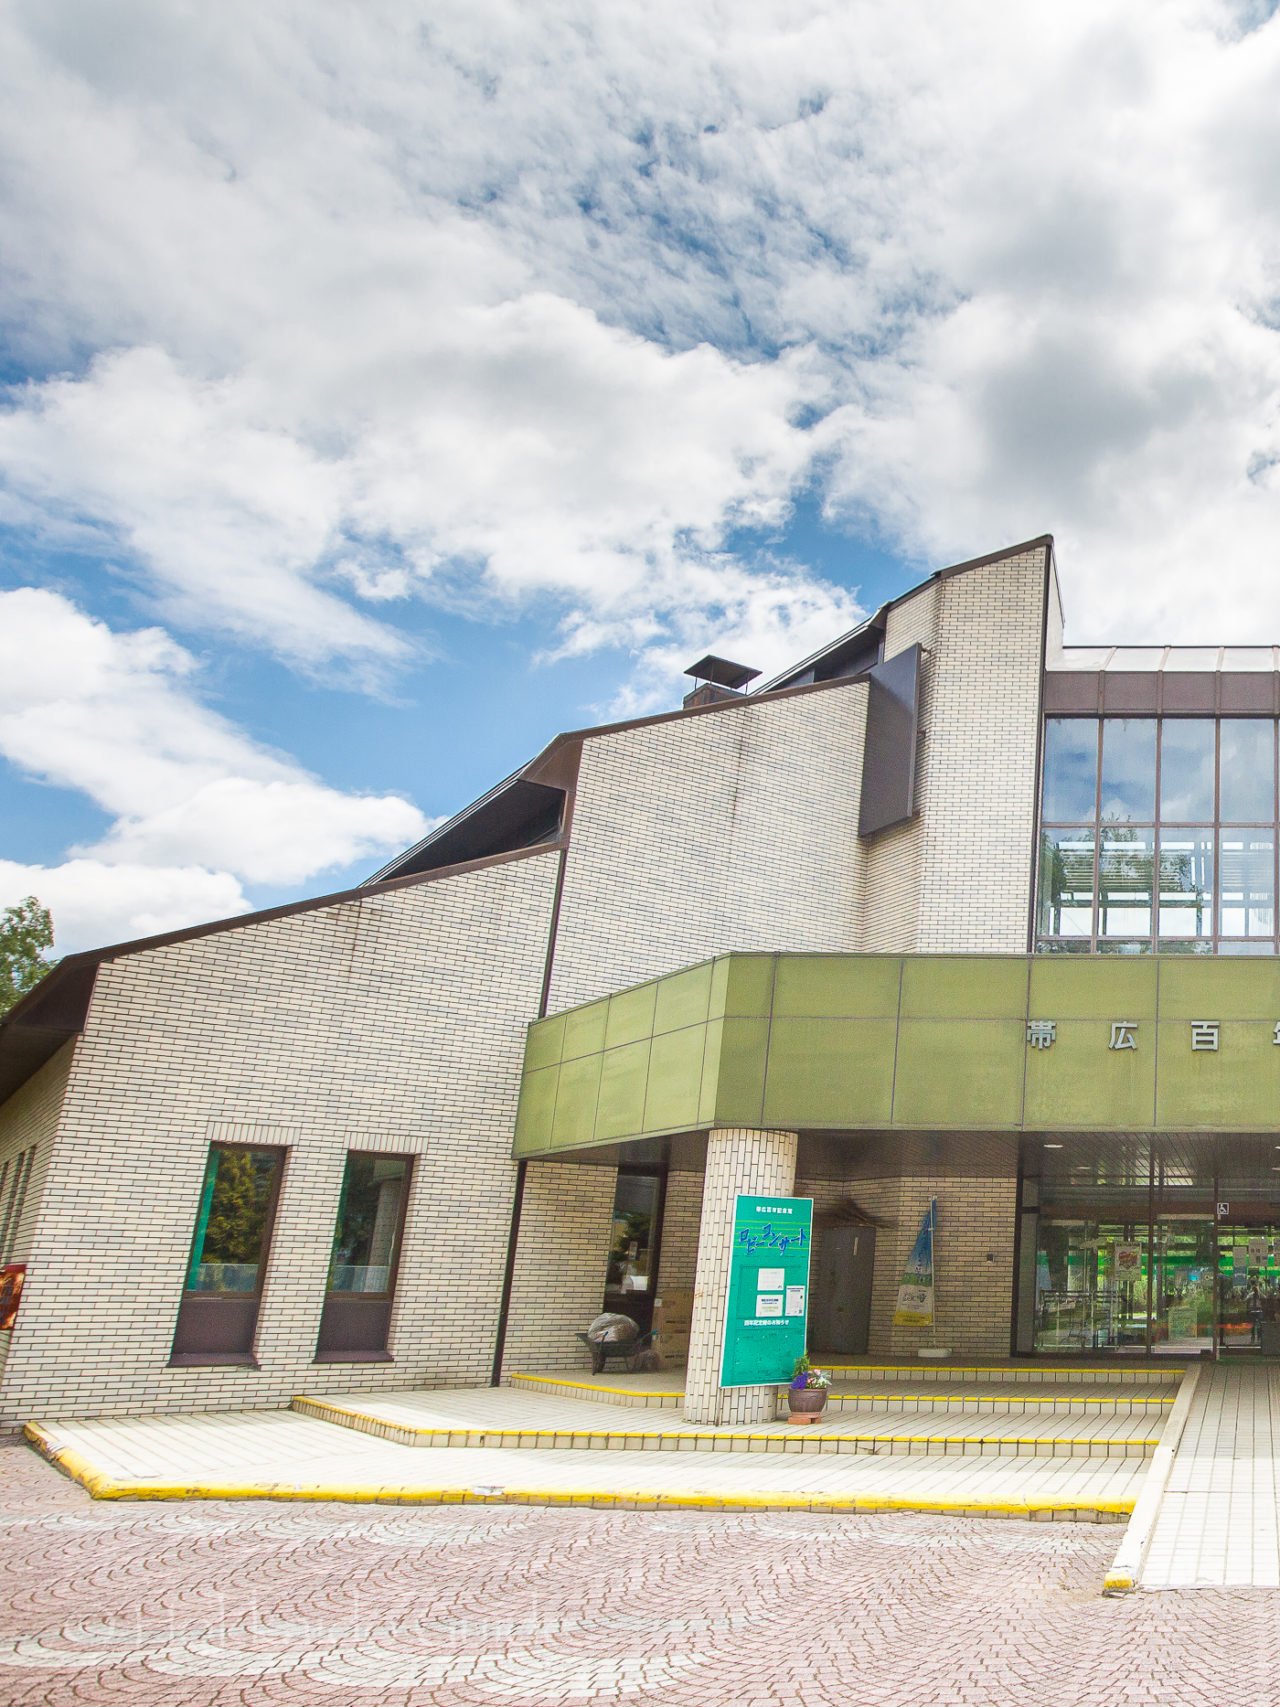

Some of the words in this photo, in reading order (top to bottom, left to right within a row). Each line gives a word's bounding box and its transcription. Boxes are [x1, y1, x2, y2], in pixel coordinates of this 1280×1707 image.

[738, 1223, 807, 1256] ロビーコンサート
